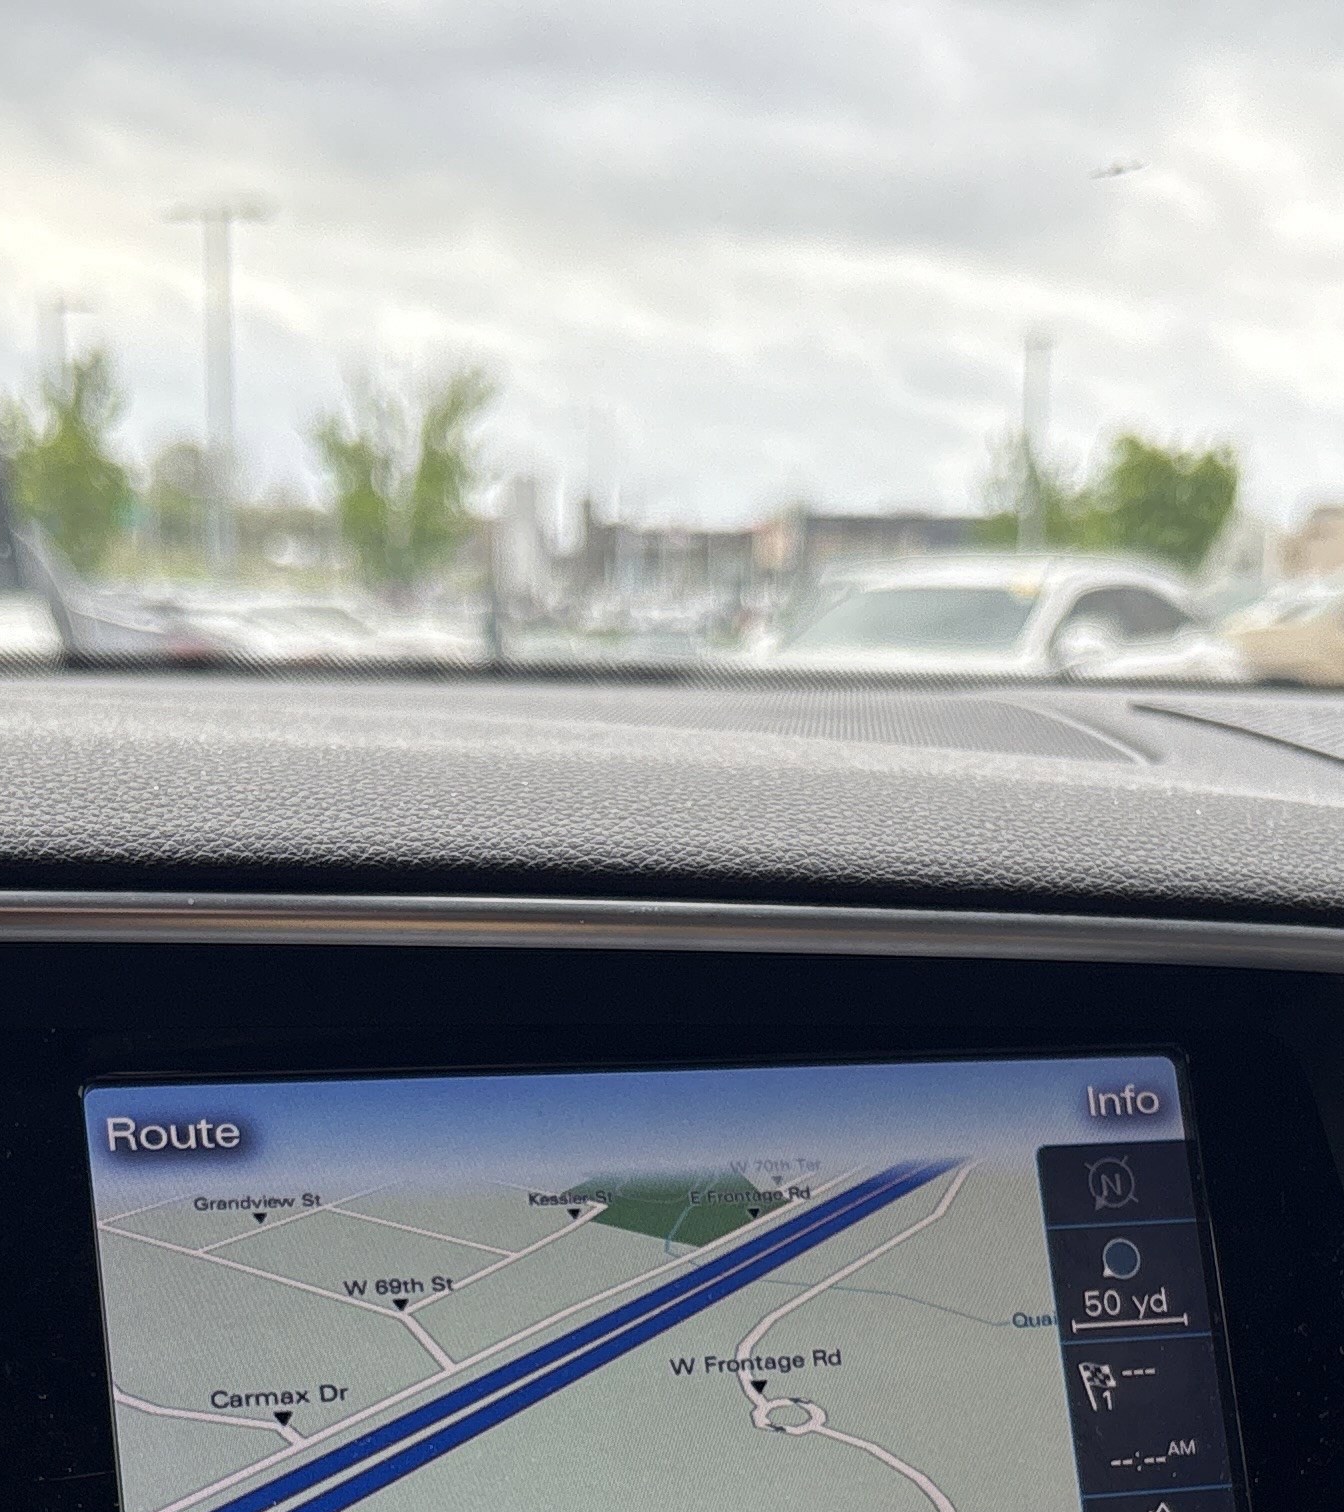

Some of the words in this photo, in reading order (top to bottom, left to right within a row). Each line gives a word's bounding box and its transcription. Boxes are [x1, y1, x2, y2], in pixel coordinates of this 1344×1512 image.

[1086, 1083, 1160, 1117] Info
[106, 1116, 241, 1152] Route
[193, 1193, 295, 1212] Grandview
[301, 1192, 322, 1207] St
[595, 1189, 613, 1204] St
[690, 1190, 700, 1204] E
[707, 1189, 784, 1206] Frontage
[788, 1185, 811, 1201] Rd
[342, 1280, 369, 1297] W
[374, 1278, 424, 1296] 69th
[431, 1275, 454, 1292] St
[1084, 1289, 1122, 1318] 50
[1131, 1286, 1169, 1320] yd
[669, 1357, 696, 1376] W
[704, 1353, 807, 1376] Frontage
[812, 1348, 843, 1368] Rd
[210, 1388, 311, 1411] Carmax
[318, 1384, 349, 1405] Dr
